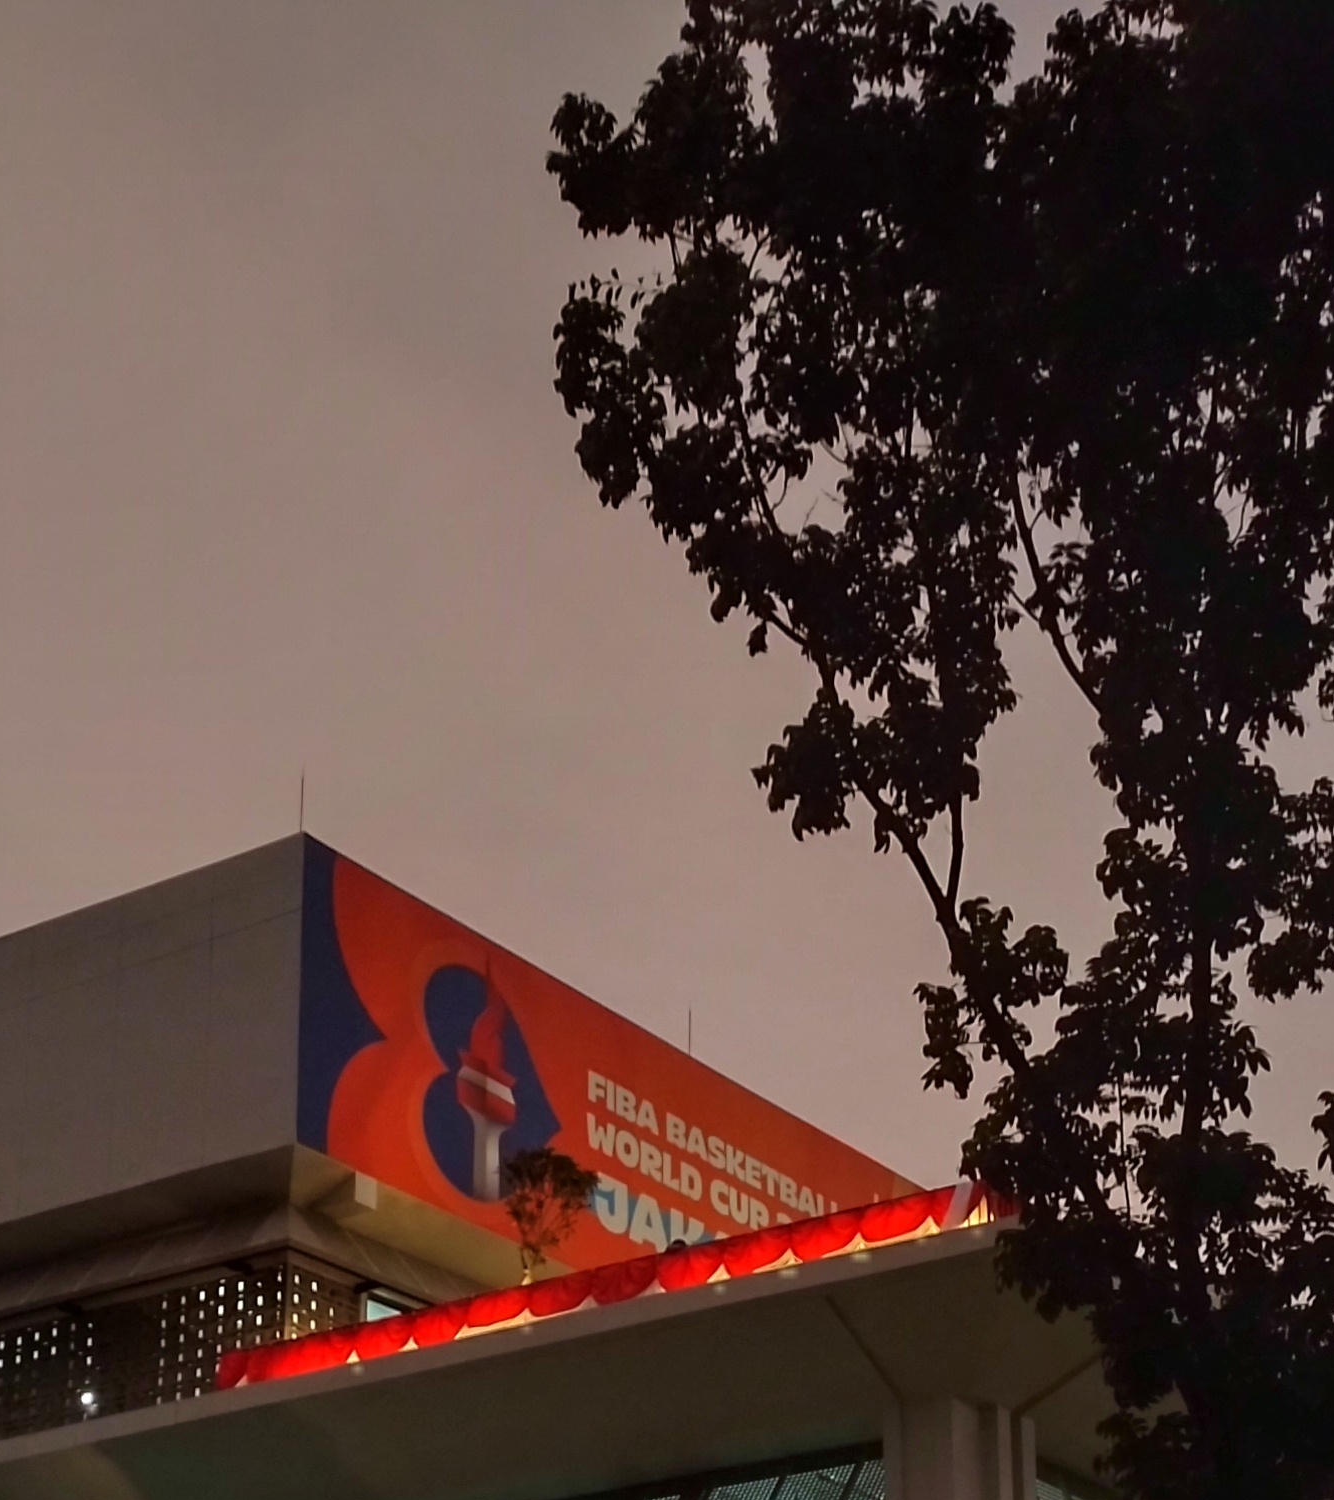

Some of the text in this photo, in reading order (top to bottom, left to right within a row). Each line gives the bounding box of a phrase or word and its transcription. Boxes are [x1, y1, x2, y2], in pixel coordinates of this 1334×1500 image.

[588, 1070, 659, 1135] FIBA
[586, 1112, 769, 1231] WORLD CUP
